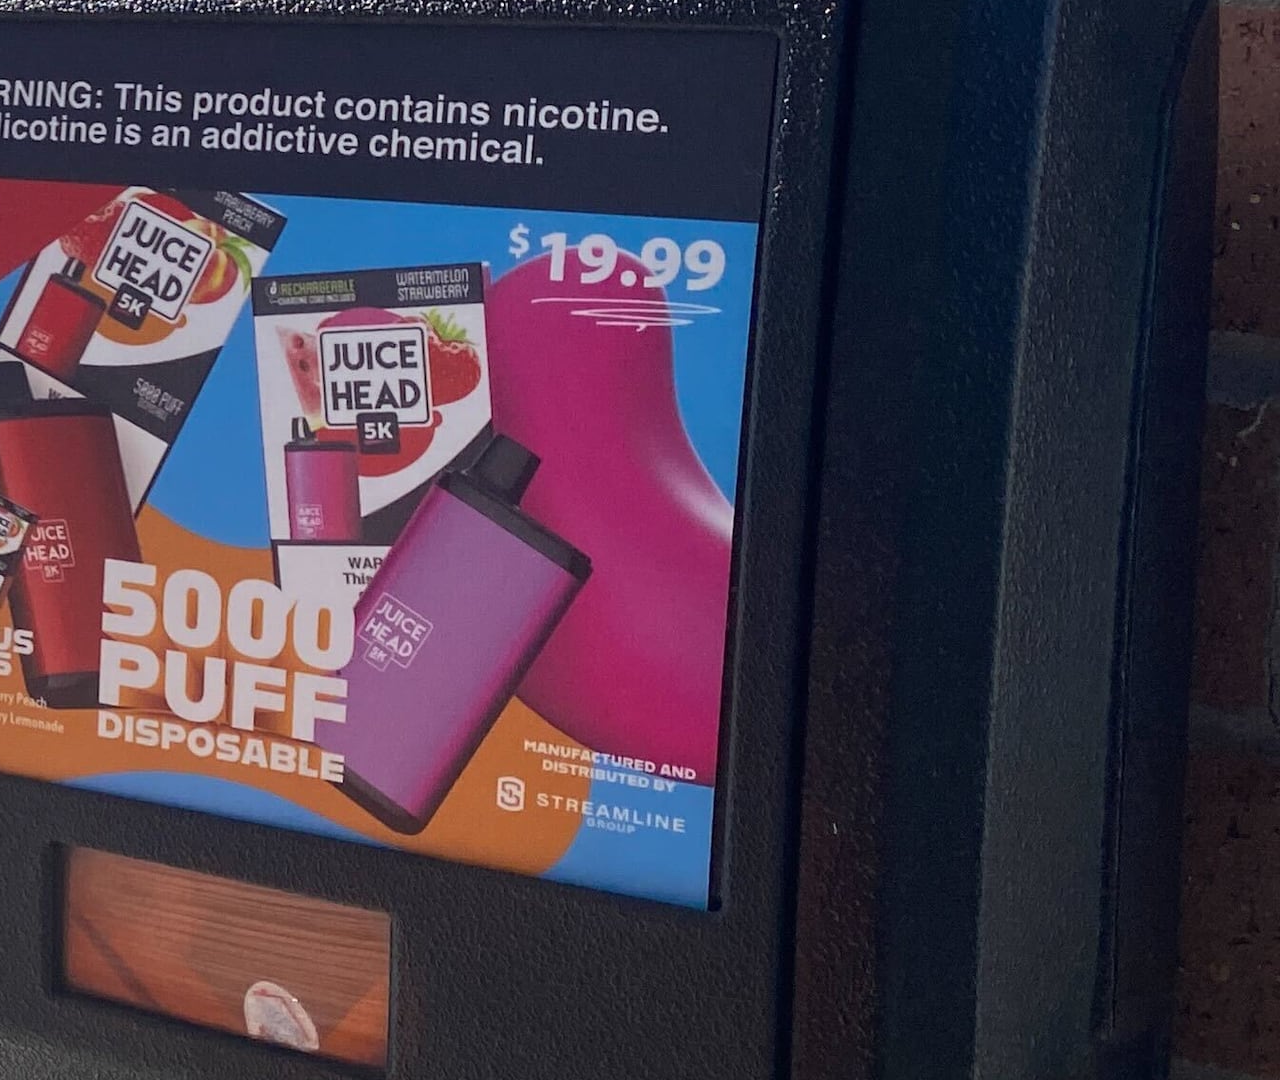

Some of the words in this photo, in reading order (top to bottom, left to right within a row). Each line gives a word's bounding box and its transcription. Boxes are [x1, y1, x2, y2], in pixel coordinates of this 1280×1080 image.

[114, 82, 182, 114] This
[192, 85, 325, 120] product
[334, 94, 490, 127] contains
[503, 97, 669, 134] nicotine.
[114, 117, 141, 147] is
[151, 124, 190, 148] an
[201, 120, 359, 157] addictive
[369, 128, 543, 165] chemical.
[121, 216, 201, 273] JUICE
[508, 223, 726, 291] $19.99
[106, 245, 183, 302] HEAD
[280, 279, 354, 296] RECHARGEABLE
[396, 268, 469, 286] WATERMELON
[117, 292, 145, 317] 5K
[398, 285, 469, 301] STRAWBERRY
[329, 340, 418, 371] JUICE
[331, 379, 421, 411] HEAD
[364, 422, 393, 439] 5K
[26, 544, 69, 562] HEAD
[101, 558, 356, 670] 5000
[376, 601, 427, 642] JUICE
[365, 617, 413, 658] HEAD
[16, 694, 47, 708] Peach
[98, 638, 348, 743] PUFF
[10, 712, 65, 733] Lemonade
[98, 711, 345, 783] DISPOSABLE
[524, 739, 656, 774] MANUFACTURED
[660, 764, 697, 780] AND
[542, 759, 650, 789] DISTRIBUTED
[653, 778, 677, 793] BY
[536, 792, 686, 834] STREAMLINE
[586, 819, 636, 834] GROUP
